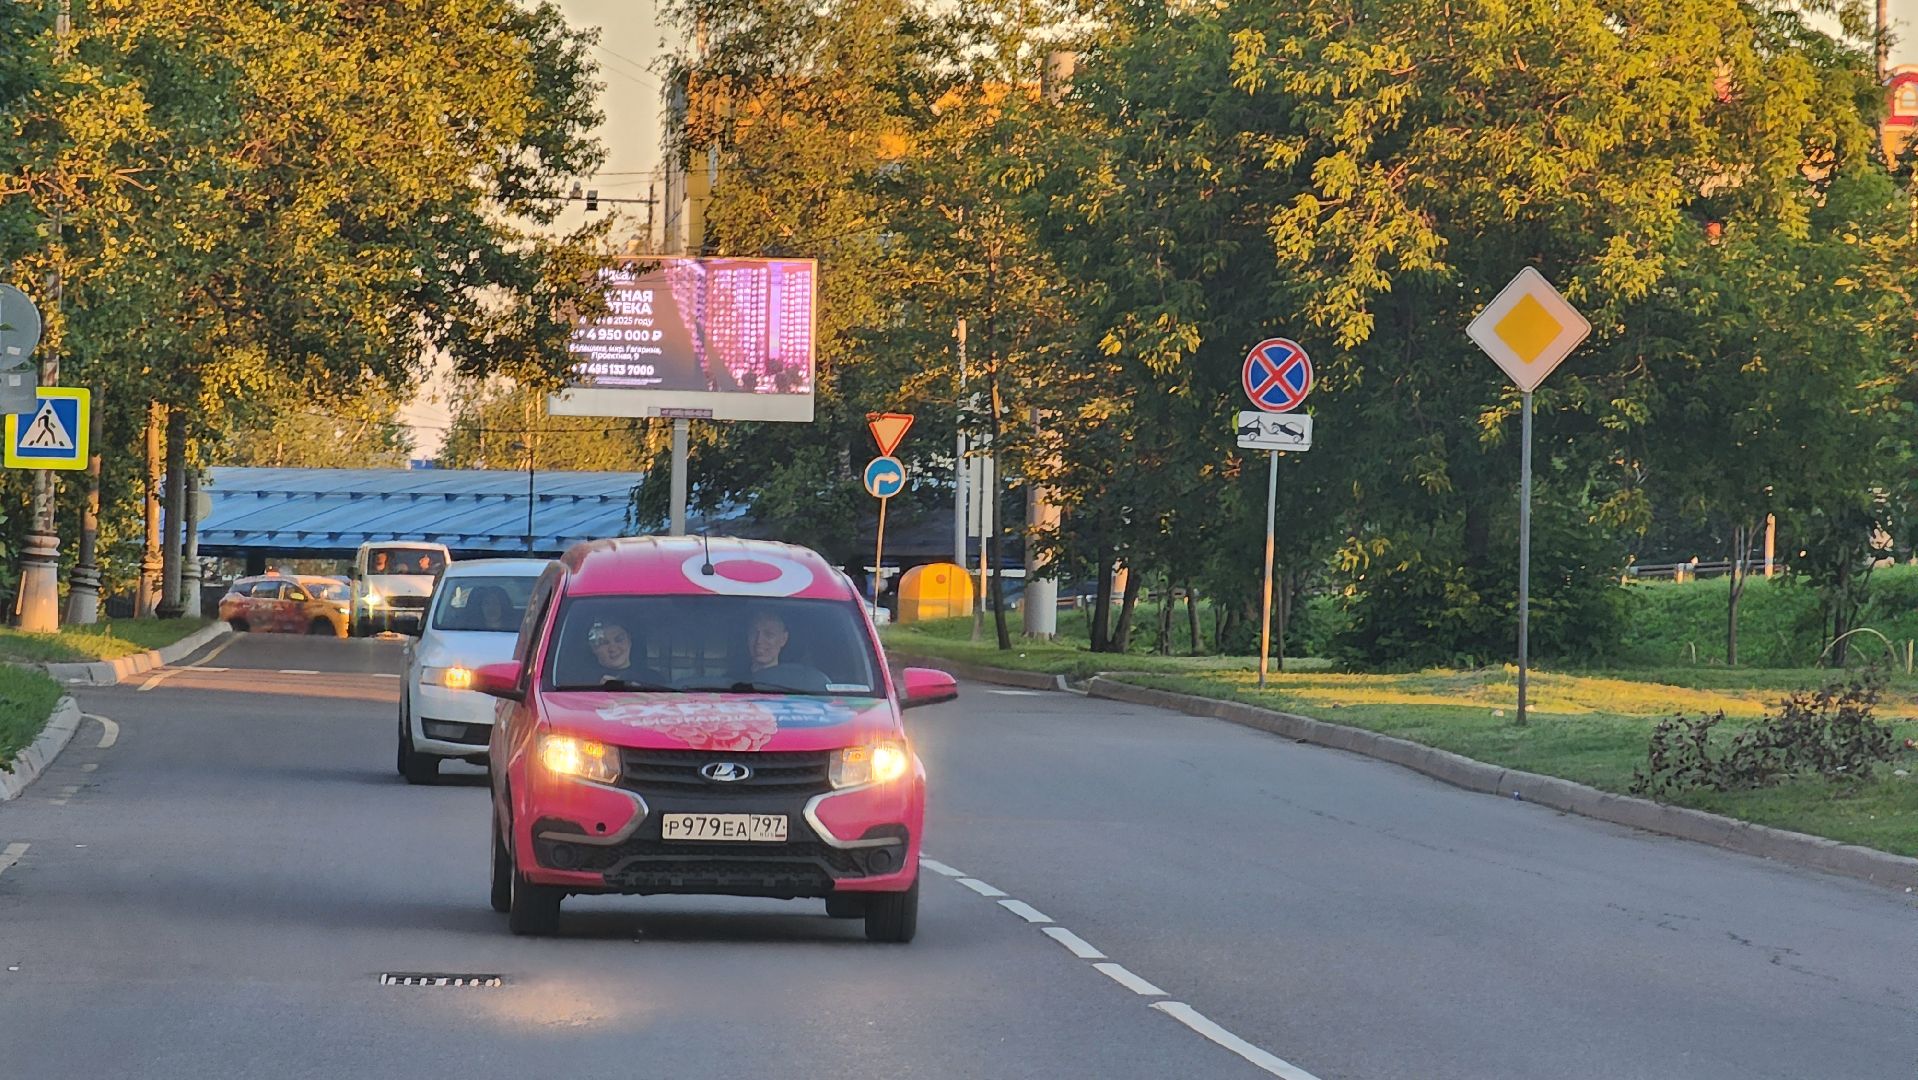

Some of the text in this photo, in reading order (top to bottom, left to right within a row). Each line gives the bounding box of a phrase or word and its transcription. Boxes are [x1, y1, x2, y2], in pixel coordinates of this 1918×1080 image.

[613, 316, 633, 325] 2025
[586, 327, 597, 341] 4
[598, 328, 622, 341] 950
[624, 329, 649, 342] 000
[627, 364, 655, 376] 7000
